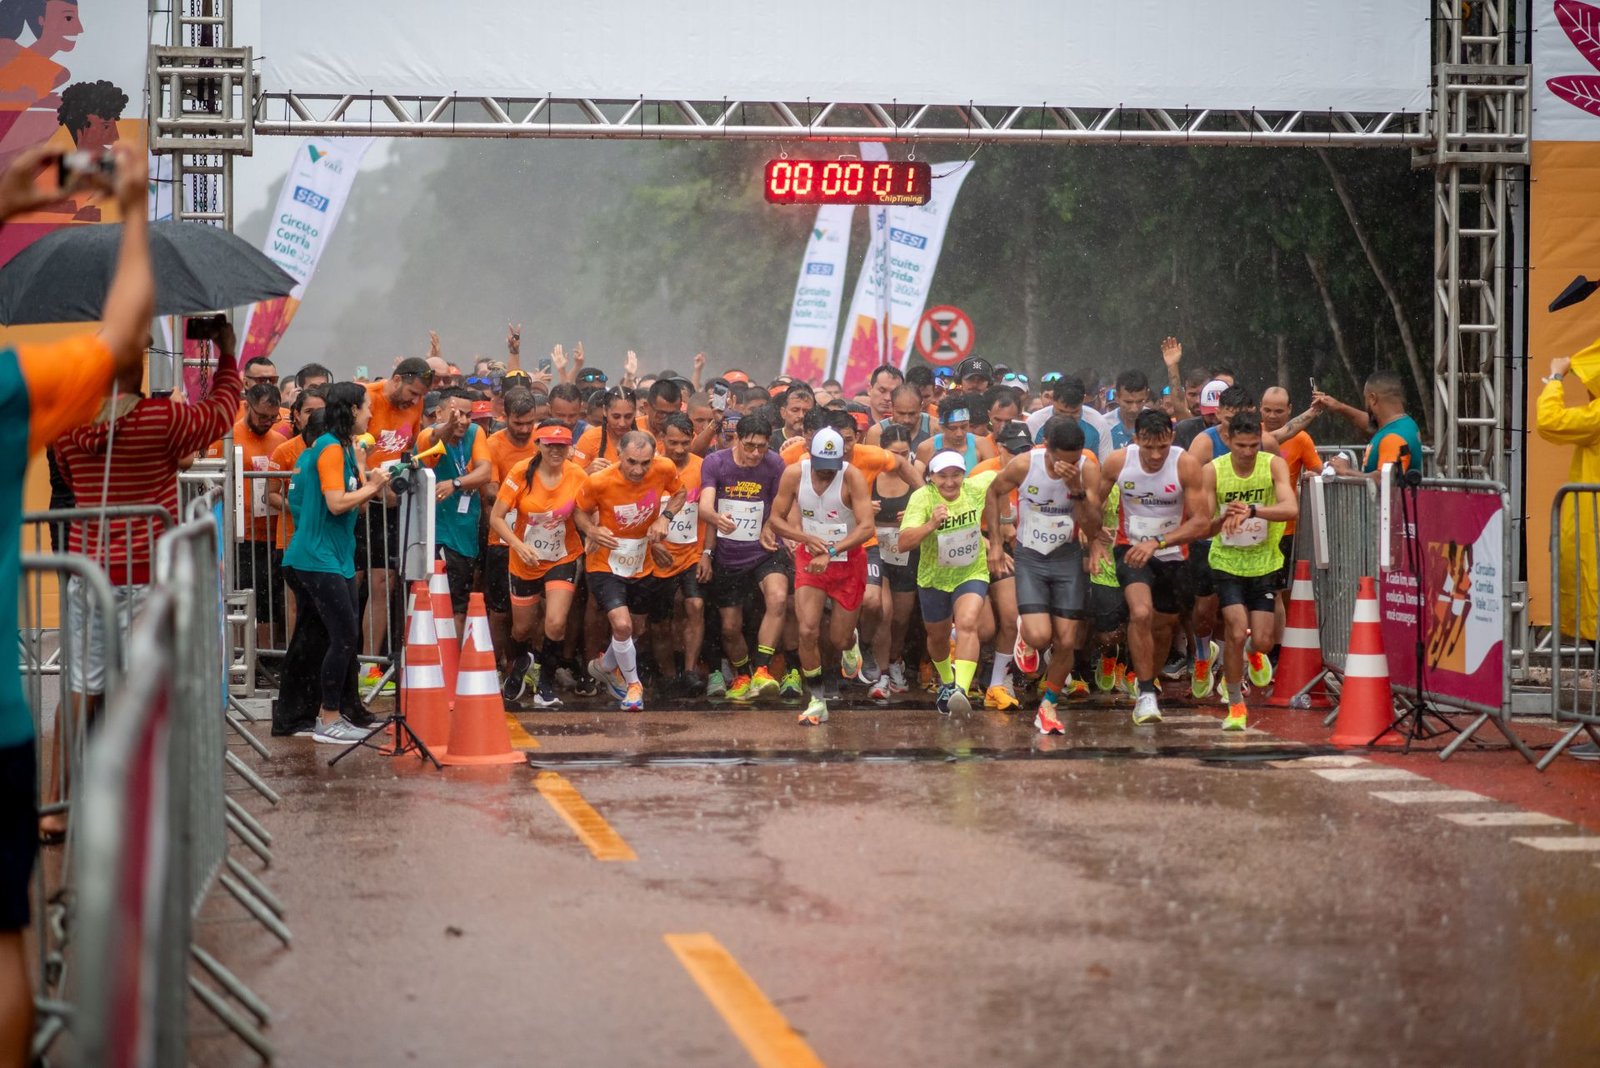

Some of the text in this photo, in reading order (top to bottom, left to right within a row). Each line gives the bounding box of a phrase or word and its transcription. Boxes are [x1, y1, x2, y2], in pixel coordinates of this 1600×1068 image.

[771, 162, 813, 195] 00
[821, 163, 864, 196] 00
[879, 194, 923, 205] ChipTiming
[273, 240, 297, 257] Vale
[734, 518, 758, 530] 772
[1032, 529, 1067, 544] 0699
[534, 538, 561, 552] 0773
[948, 540, 979, 559] 0886
